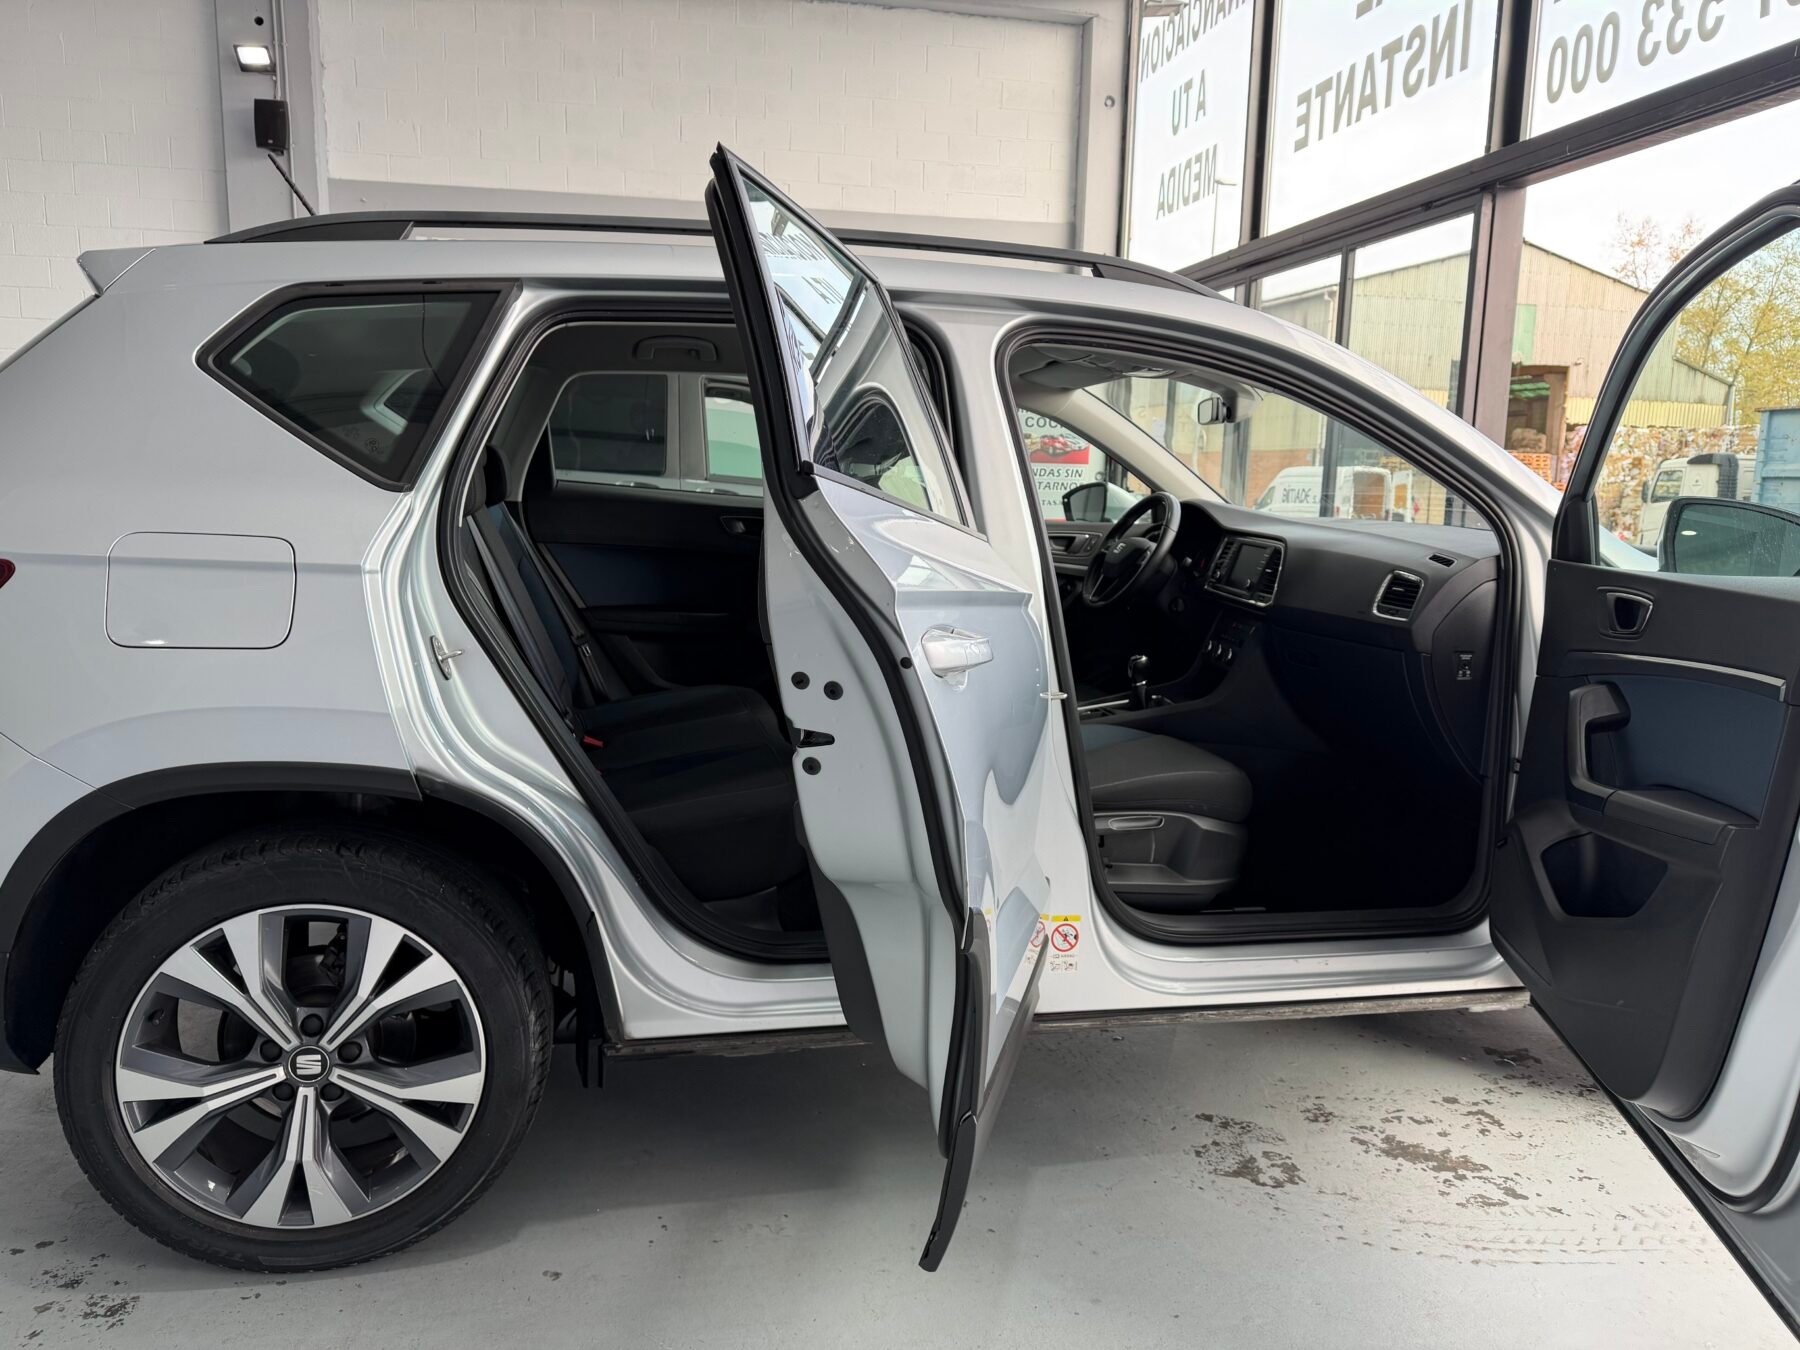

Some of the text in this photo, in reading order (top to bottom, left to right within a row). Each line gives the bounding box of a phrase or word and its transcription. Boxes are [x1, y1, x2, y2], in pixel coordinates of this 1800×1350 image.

[1025, 416, 1063, 429] COC
[1065, 468, 1083, 478] SIN
[1036, 481, 1081, 491] TARNO
